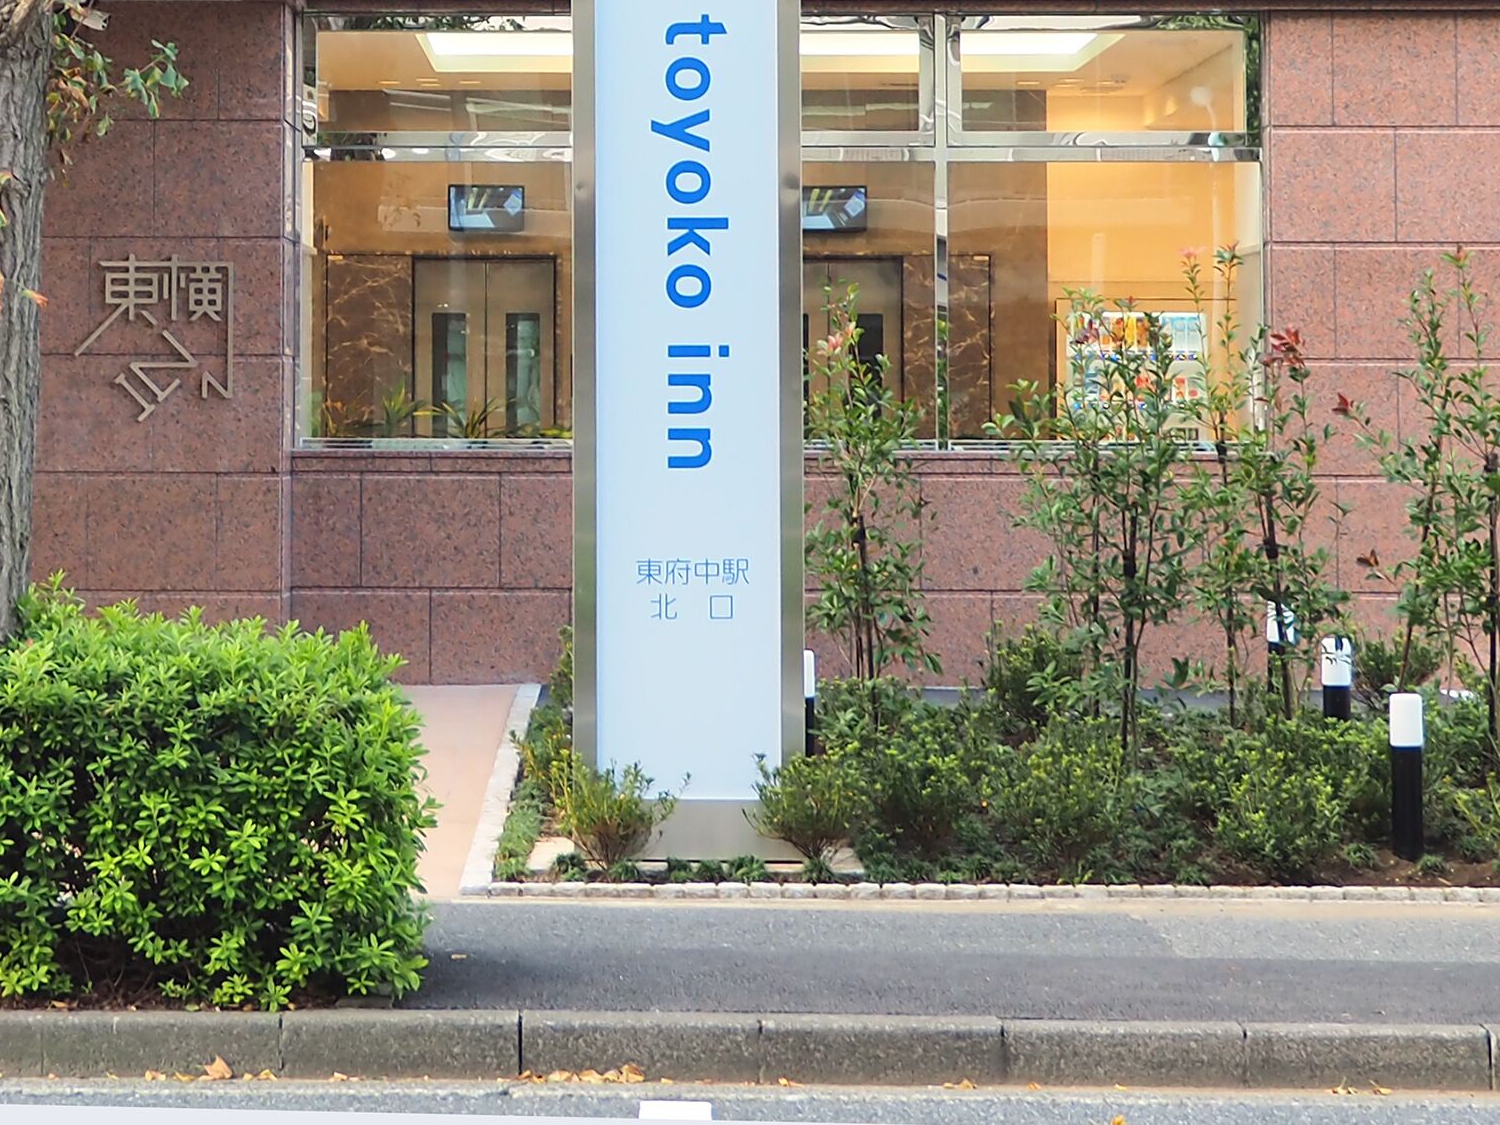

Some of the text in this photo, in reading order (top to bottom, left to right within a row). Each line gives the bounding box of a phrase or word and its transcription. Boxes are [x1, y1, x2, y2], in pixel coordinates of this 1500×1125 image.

[650, 13, 730, 469] toyoko inn
[635, 557, 750, 585] 東府中駅
